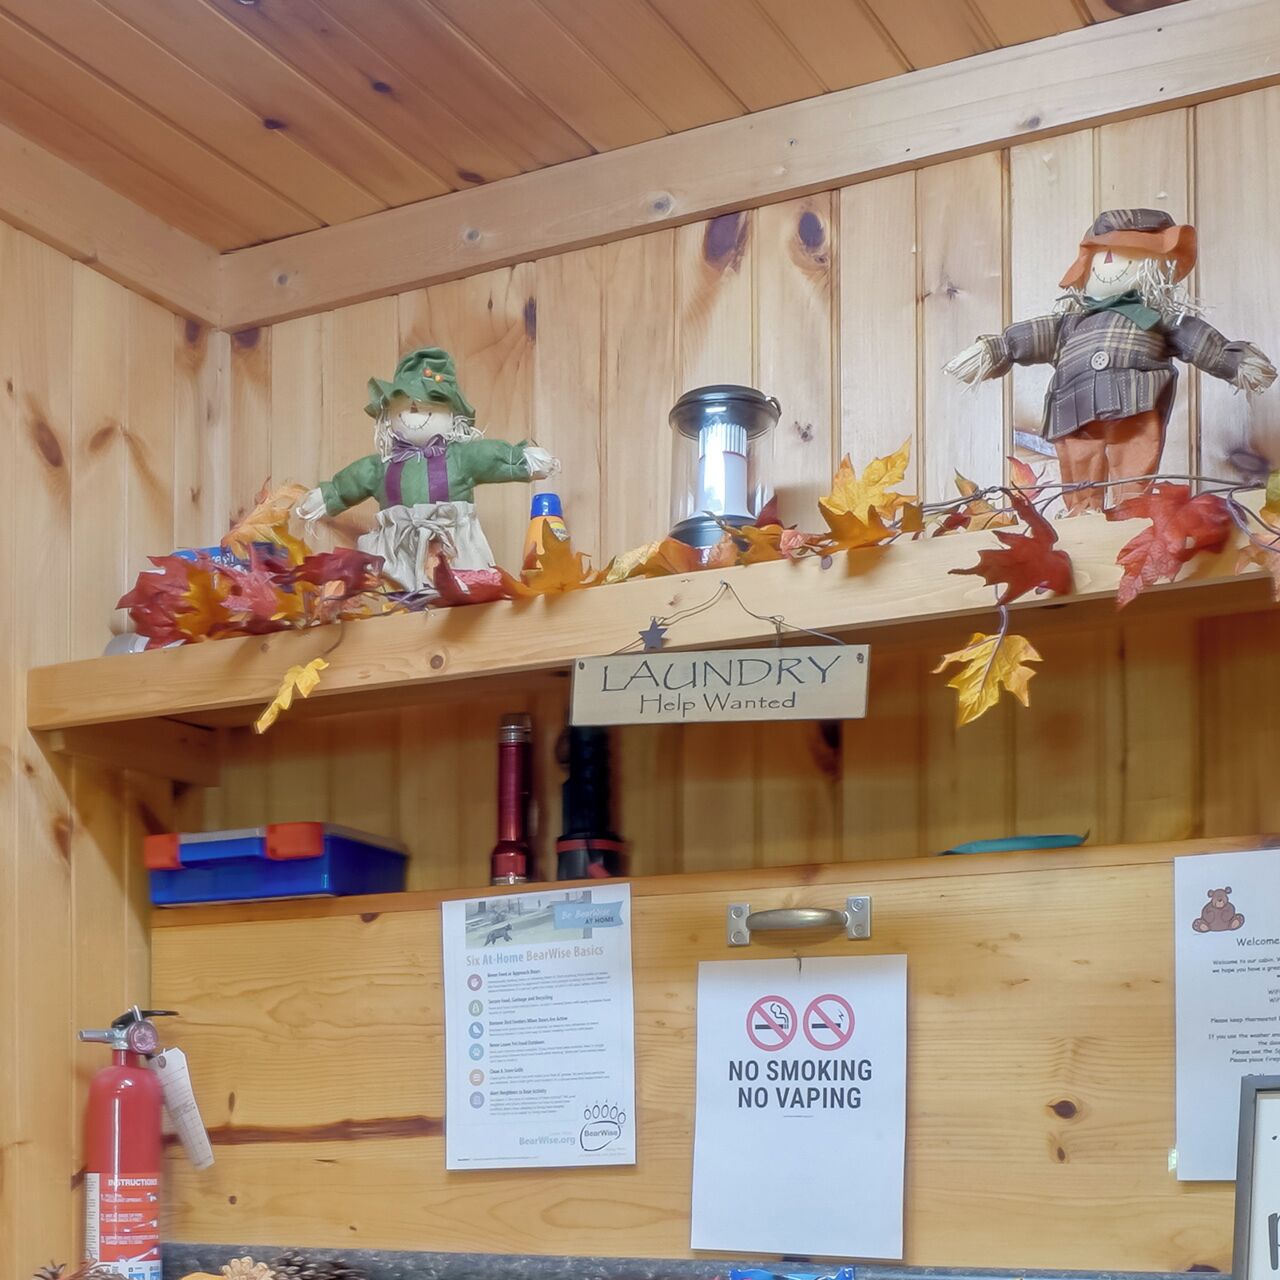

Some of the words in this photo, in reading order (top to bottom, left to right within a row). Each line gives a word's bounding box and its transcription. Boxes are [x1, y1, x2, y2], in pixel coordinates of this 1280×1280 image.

[601, 655, 842, 692] LAUNDRY
[640, 693, 696, 718] Help
[703, 691, 796, 712] Wanted
[1236, 937, 1280, 946] Welcome
[466, 956, 480, 966] Six
[482, 952, 524, 966] At-Home
[526, 948, 571, 962] BearWise
[574, 944, 604, 957] Basics
[728, 1060, 759, 1082] NO
[766, 1060, 872, 1082] SMOKING
[738, 1086, 768, 1108] NO
[776, 1086, 862, 1108] VAPING
[520, 1136, 576, 1146] BearWise.org
